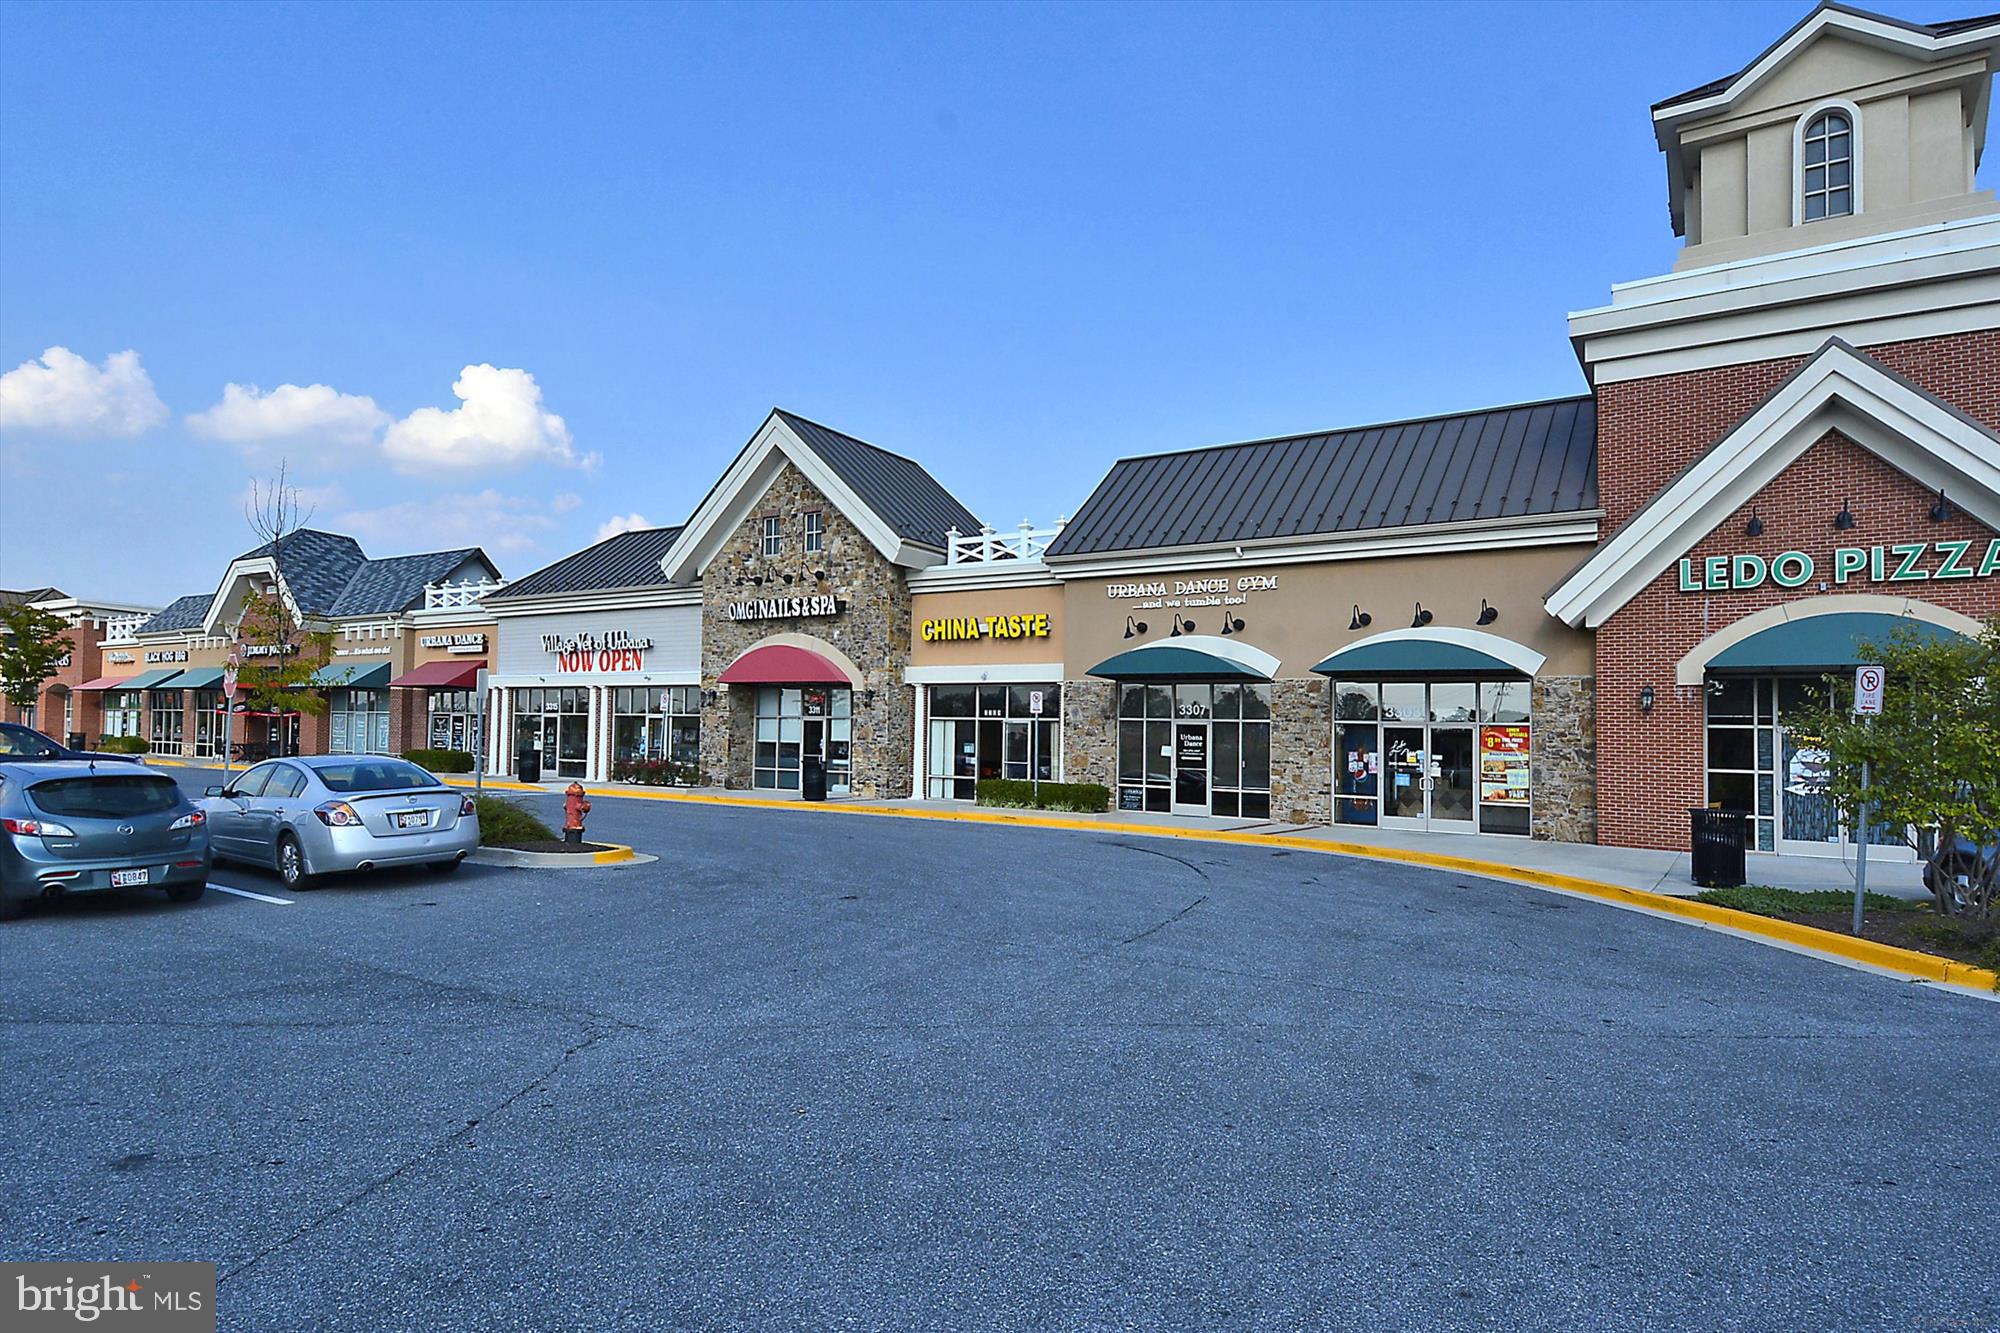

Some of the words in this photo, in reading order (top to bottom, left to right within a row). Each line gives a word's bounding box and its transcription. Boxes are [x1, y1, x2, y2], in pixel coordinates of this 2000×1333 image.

[1679, 550, 1815, 592] LEDO
[1107, 582, 1168, 598] URBANA
[1174, 578, 1229, 595] DANCE
[1237, 575, 1278, 591] GYM
[1166, 599, 1181, 608] we
[1184, 596, 1221, 607] tumble
[1224, 593, 1247, 605] too!
[921, 617, 980, 641] CHINA
[984, 614, 1048, 638] TASTE
[420, 635, 453, 647] URBANA
[454, 633, 483, 645] DANCE
[540, 633, 576, 655] Village
[557, 649, 595, 672] NOW
[599, 648, 643, 672] OPEN
[1179, 704, 1206, 716] 3307
[1180, 733, 1203, 741] Urbana
